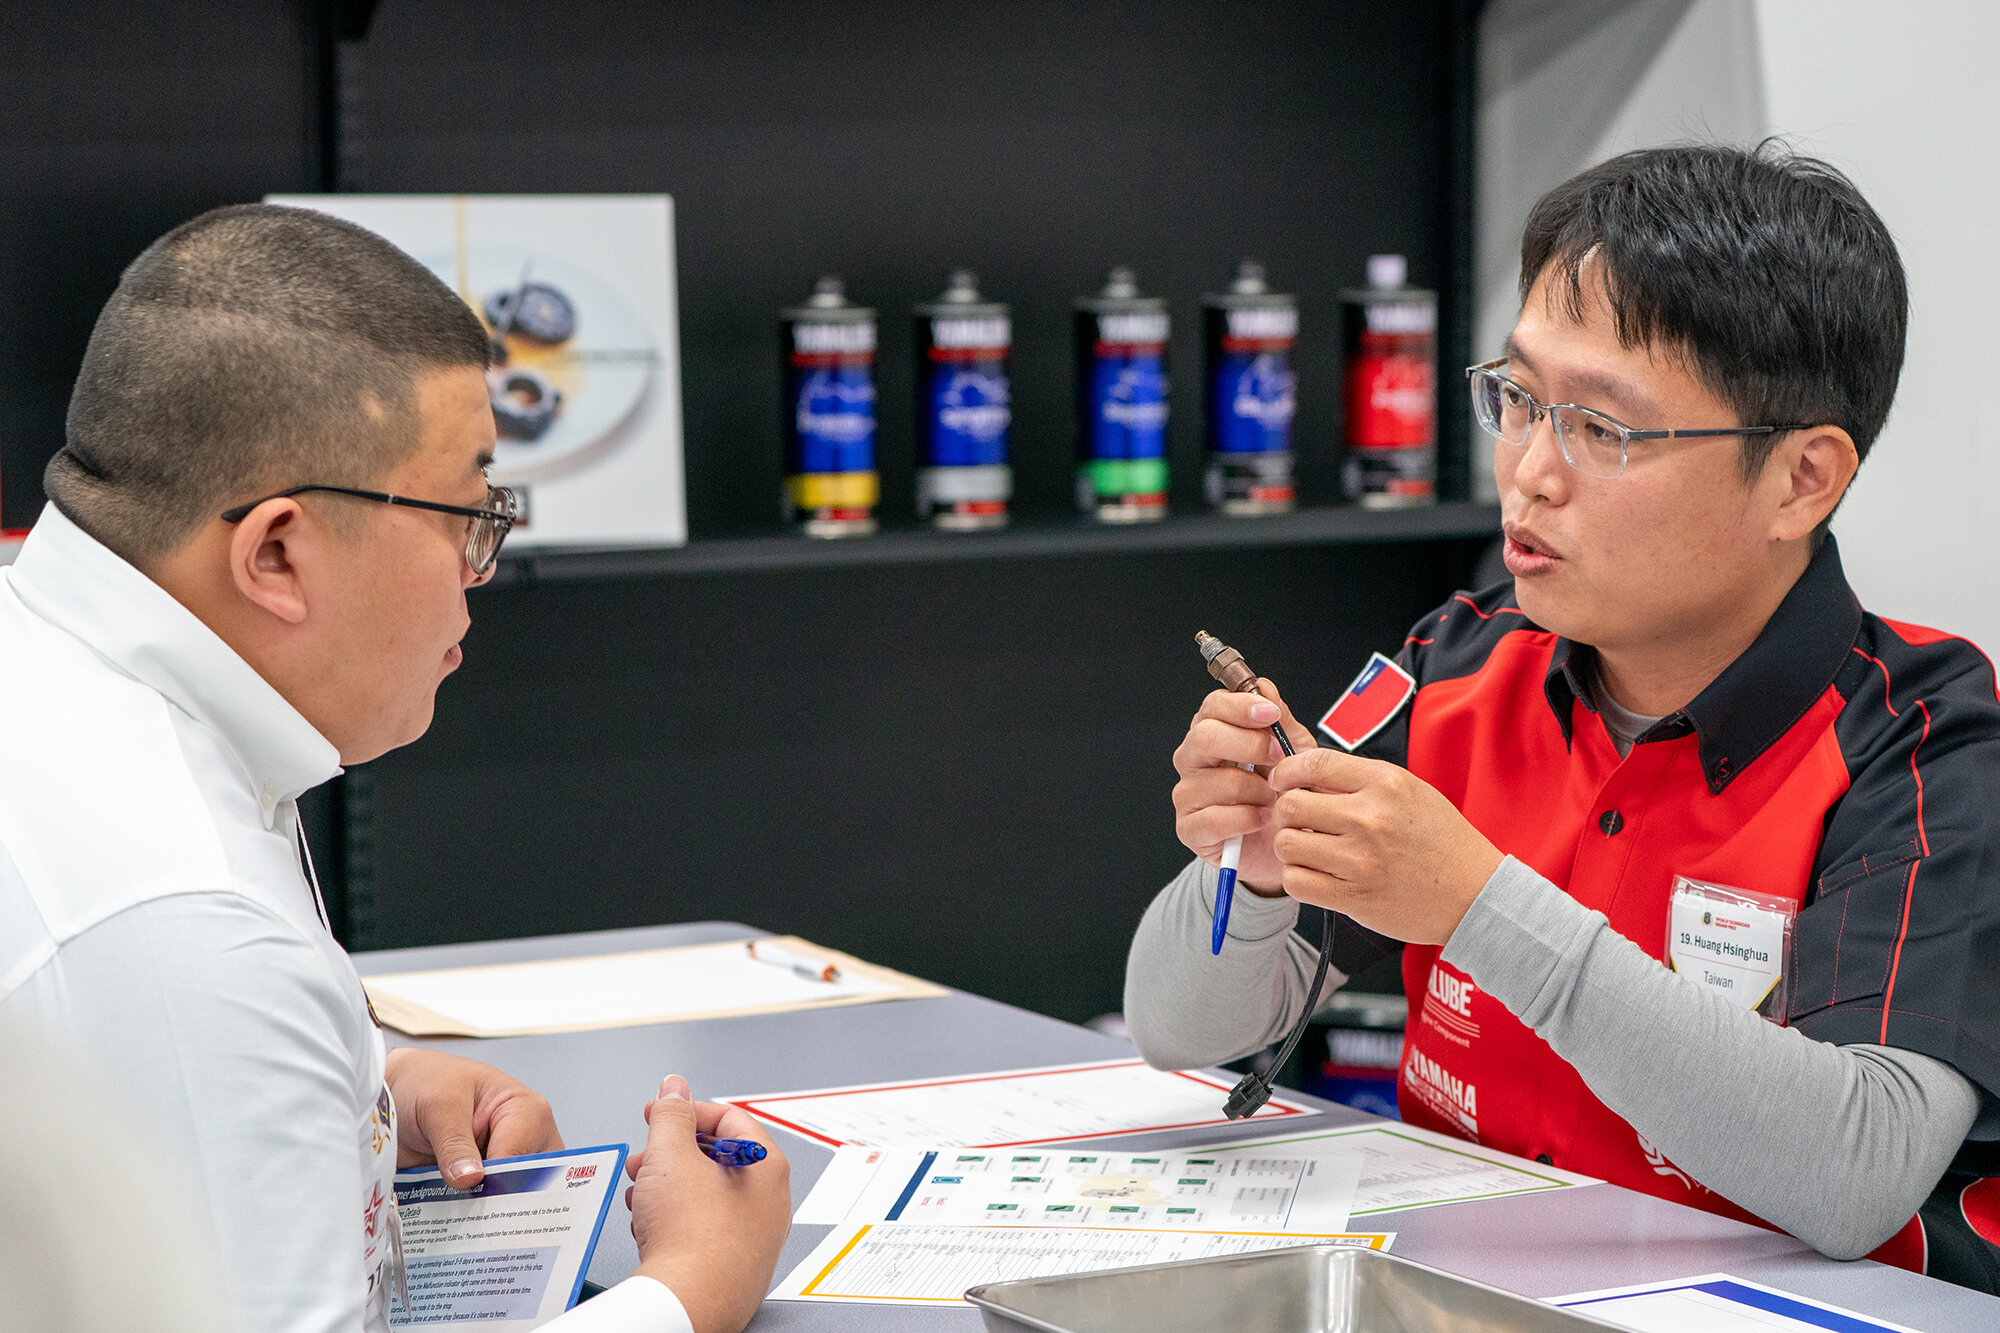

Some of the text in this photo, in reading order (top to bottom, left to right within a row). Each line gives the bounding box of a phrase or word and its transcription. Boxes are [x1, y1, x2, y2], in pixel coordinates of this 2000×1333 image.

[1680, 932, 1768, 962] 19. Huang Hsinghua
[1704, 970, 1733, 989] Taiwan
[573, 1164, 597, 1180] YAMAHA
[410, 1184, 446, 1200] background
[404, 1206, 422, 1218] Details
